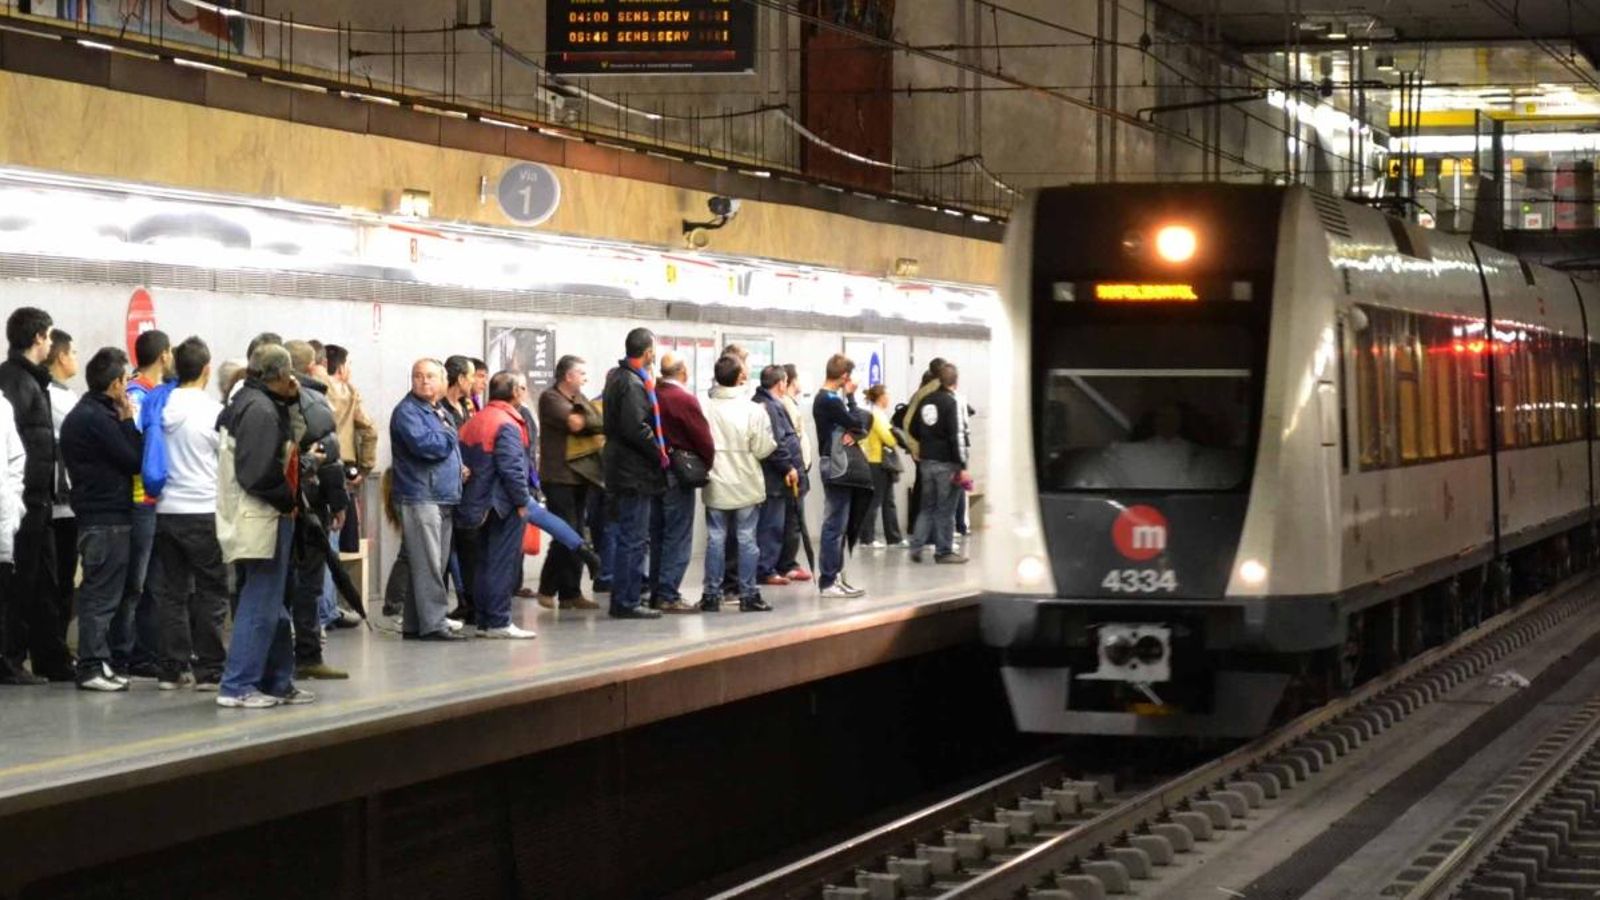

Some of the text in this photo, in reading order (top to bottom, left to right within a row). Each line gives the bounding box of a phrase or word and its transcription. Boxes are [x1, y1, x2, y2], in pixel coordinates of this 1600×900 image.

[568, 11, 609, 22] 04:00
[517, 185, 532, 214] 1
[1132, 526, 1166, 549] m
[1101, 569, 1179, 593] 4334
